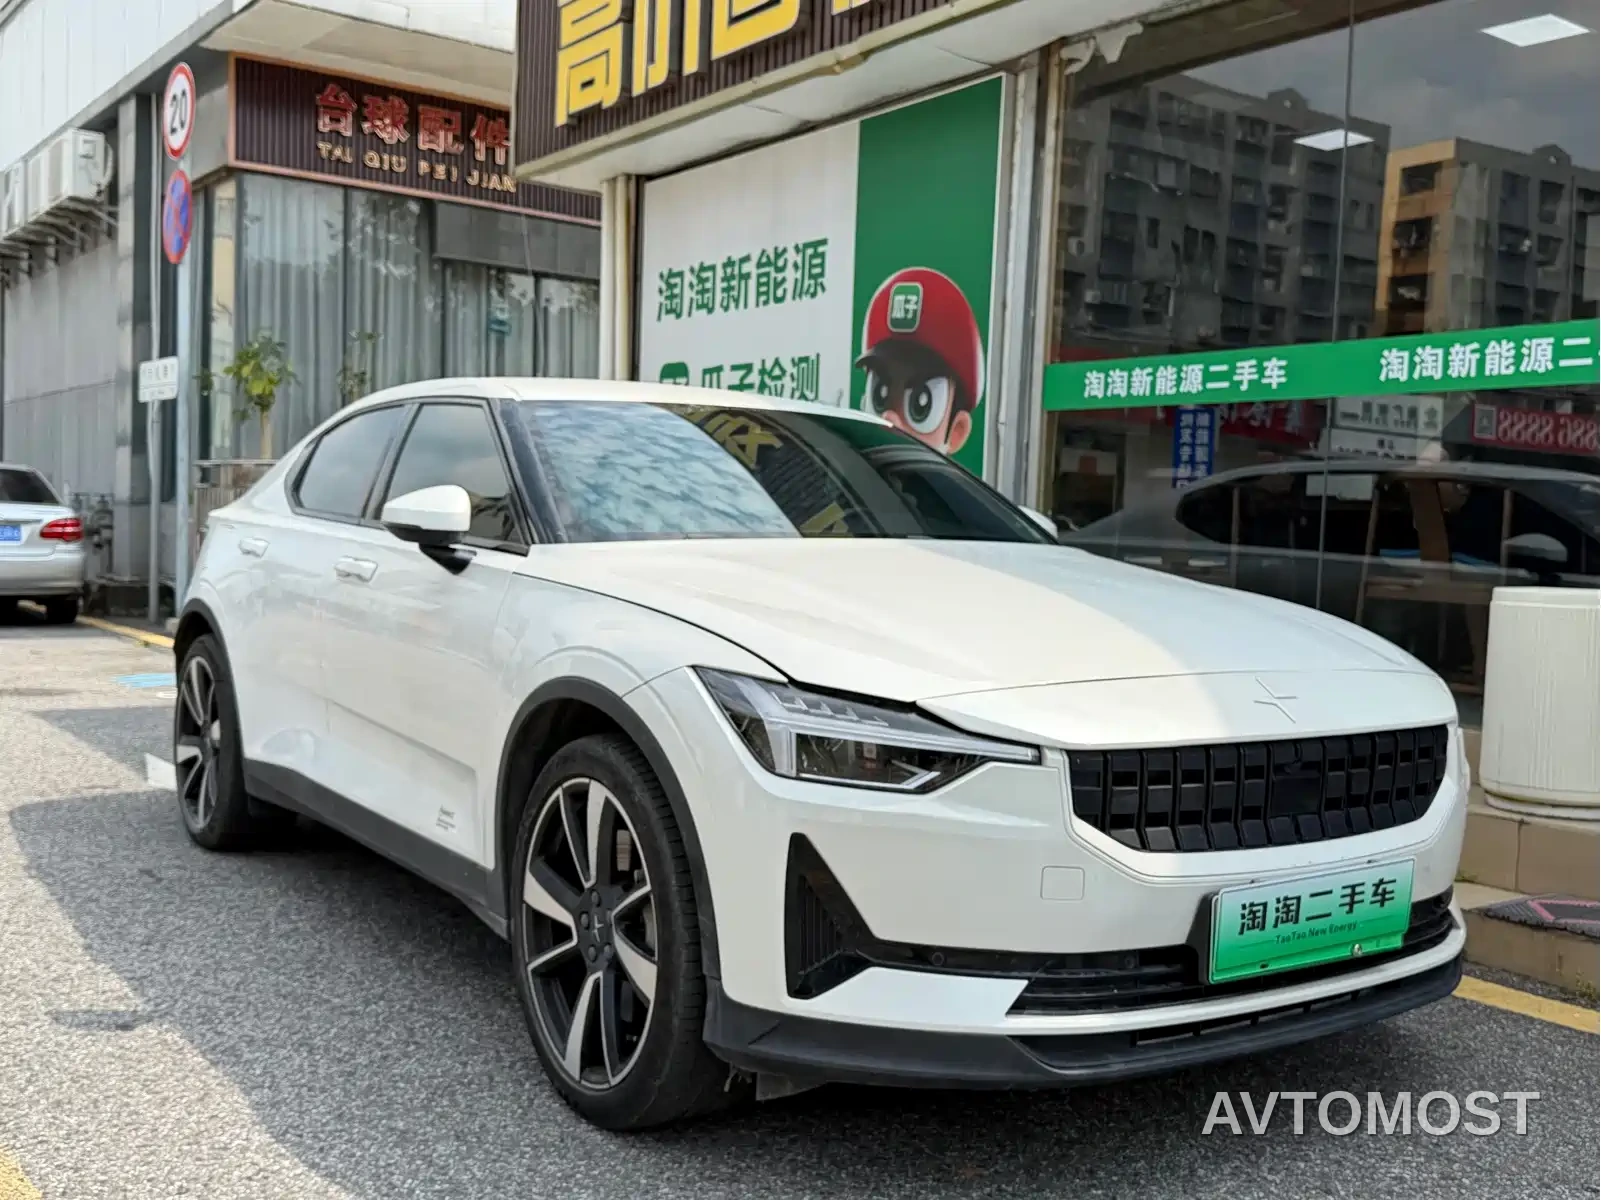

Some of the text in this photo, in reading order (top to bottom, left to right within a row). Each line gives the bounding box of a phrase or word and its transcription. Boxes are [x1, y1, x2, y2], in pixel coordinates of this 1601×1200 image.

[169, 88, 188, 136] 20
[316, 83, 512, 165] 台球配件
[317, 141, 517, 192] TAI QIU PEI JIAN
[656, 237, 829, 322] 淘淘新能源
[891, 295, 918, 319] 瓜子
[1083, 356, 1288, 399] 淘淘新能源二手车
[1379, 336, 1599, 382] 淘淘新能源二
[1238, 877, 1396, 935] 淘淘二手车
